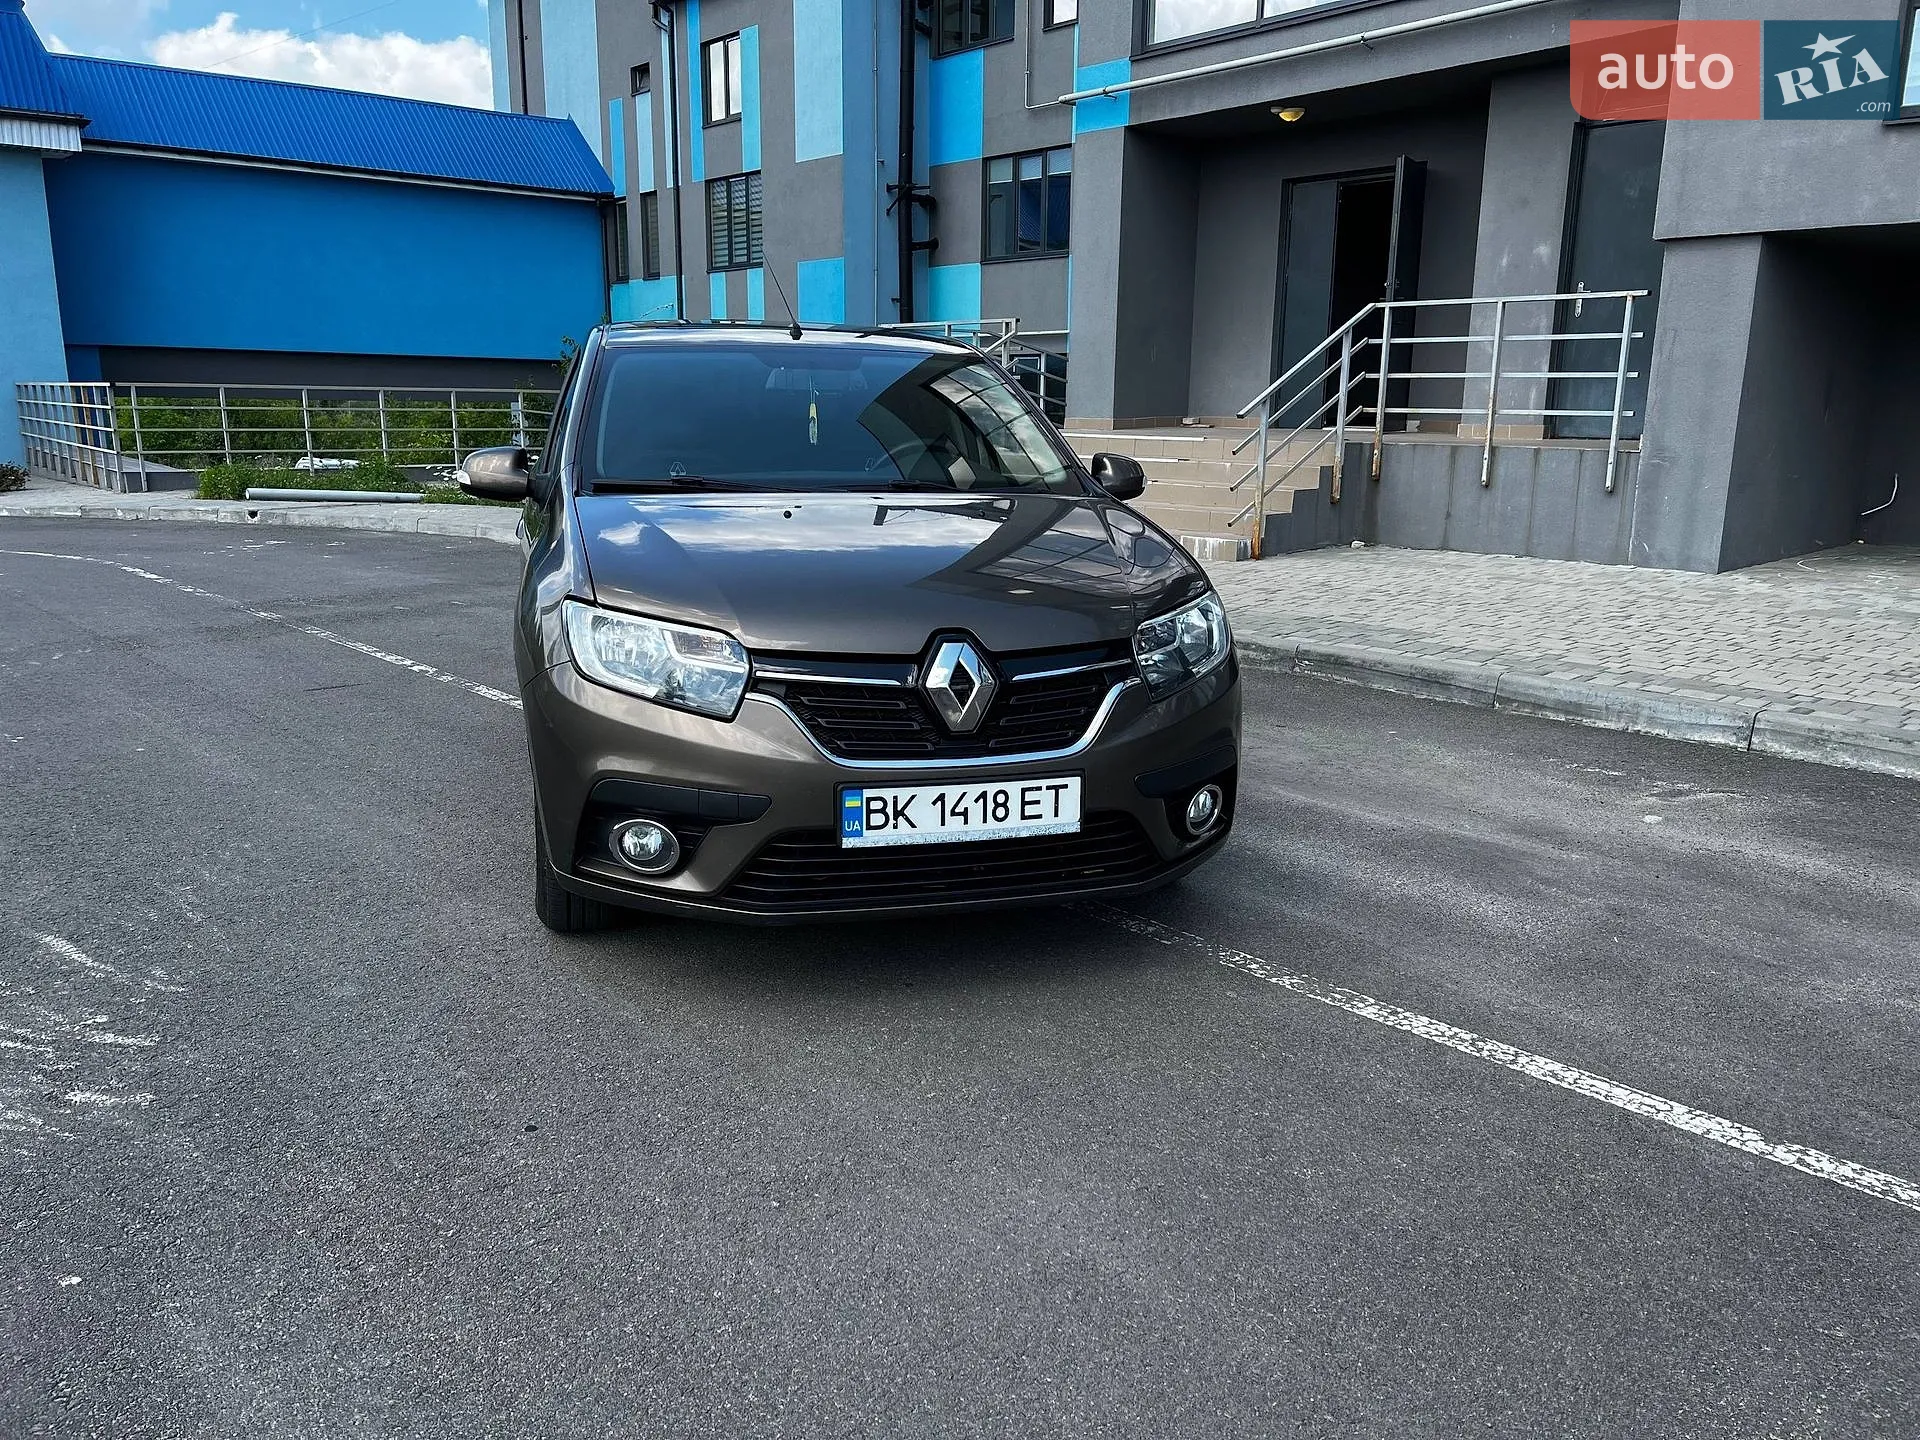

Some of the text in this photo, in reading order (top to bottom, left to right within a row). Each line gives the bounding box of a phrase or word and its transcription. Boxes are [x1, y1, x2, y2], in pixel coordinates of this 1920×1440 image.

[865, 783, 1069, 831] BK 1418 ET
[845, 820, 861, 832] UA
